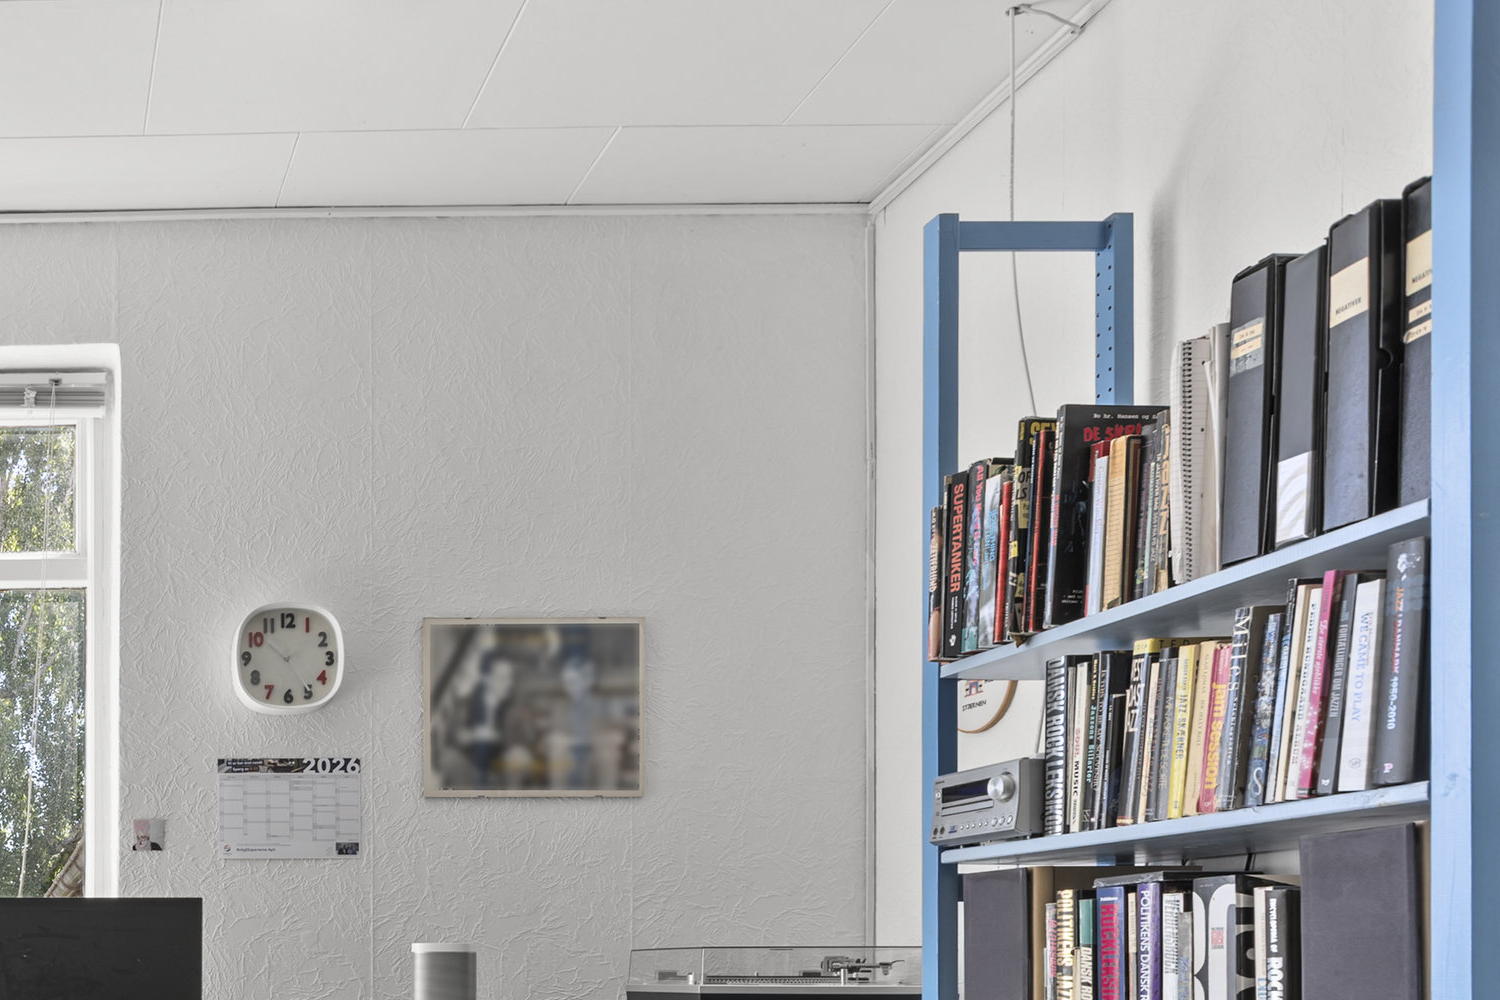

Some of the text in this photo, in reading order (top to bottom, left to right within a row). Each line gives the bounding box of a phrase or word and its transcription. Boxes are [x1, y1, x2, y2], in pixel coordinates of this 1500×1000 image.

[1083, 426, 1100, 442] DE
[950, 482, 964, 594] SUPERTANKER
[1395, 586, 1405, 611] JAZZ
[263, 618, 275, 634] 11
[280, 613, 296, 629] 12
[305, 617, 310, 633] 1
[1359, 613, 1370, 631] WE
[248, 632, 264, 648] 10
[317, 632, 328, 647] 2
[1333, 624, 1348, 676] FORTÆLLINGER
[1356, 634, 1369, 670] CAME
[1391, 619, 1403, 674] DANMARK
[241, 651, 251, 666] 9
[325, 651, 334, 666] 3
[1227, 616, 1250, 691] Miles
[250, 670, 261, 685] 8
[316, 669, 328, 685] 4
[1332, 679, 1342, 690] OM
[1355, 673, 1365, 689] TO
[264, 685, 274, 699] 7
[283, 689, 294, 704] 6
[303, 684, 313, 700] 5
[1329, 691, 1341, 718] JAZZEN
[1386, 676, 1399, 730] 1950-2010
[1351, 692, 1364, 722] PLAY
[1045, 655, 1065, 836] DANSK ROCK LEKSIKON
[1086, 705, 1098, 783] Jazzens Stillarter
[1205, 683, 1227, 789] jam session
[302, 758, 361, 773] 2026
[1072, 760, 1080, 797] MUSIC
[1056, 889, 1074, 967] POLITIKENS
[1139, 890, 1150, 952] POLITIKENS
[1164, 897, 1180, 975] VERDENSROCK
[1080, 947, 1093, 984] DANSK
[1139, 954, 1149, 992] DANSK
